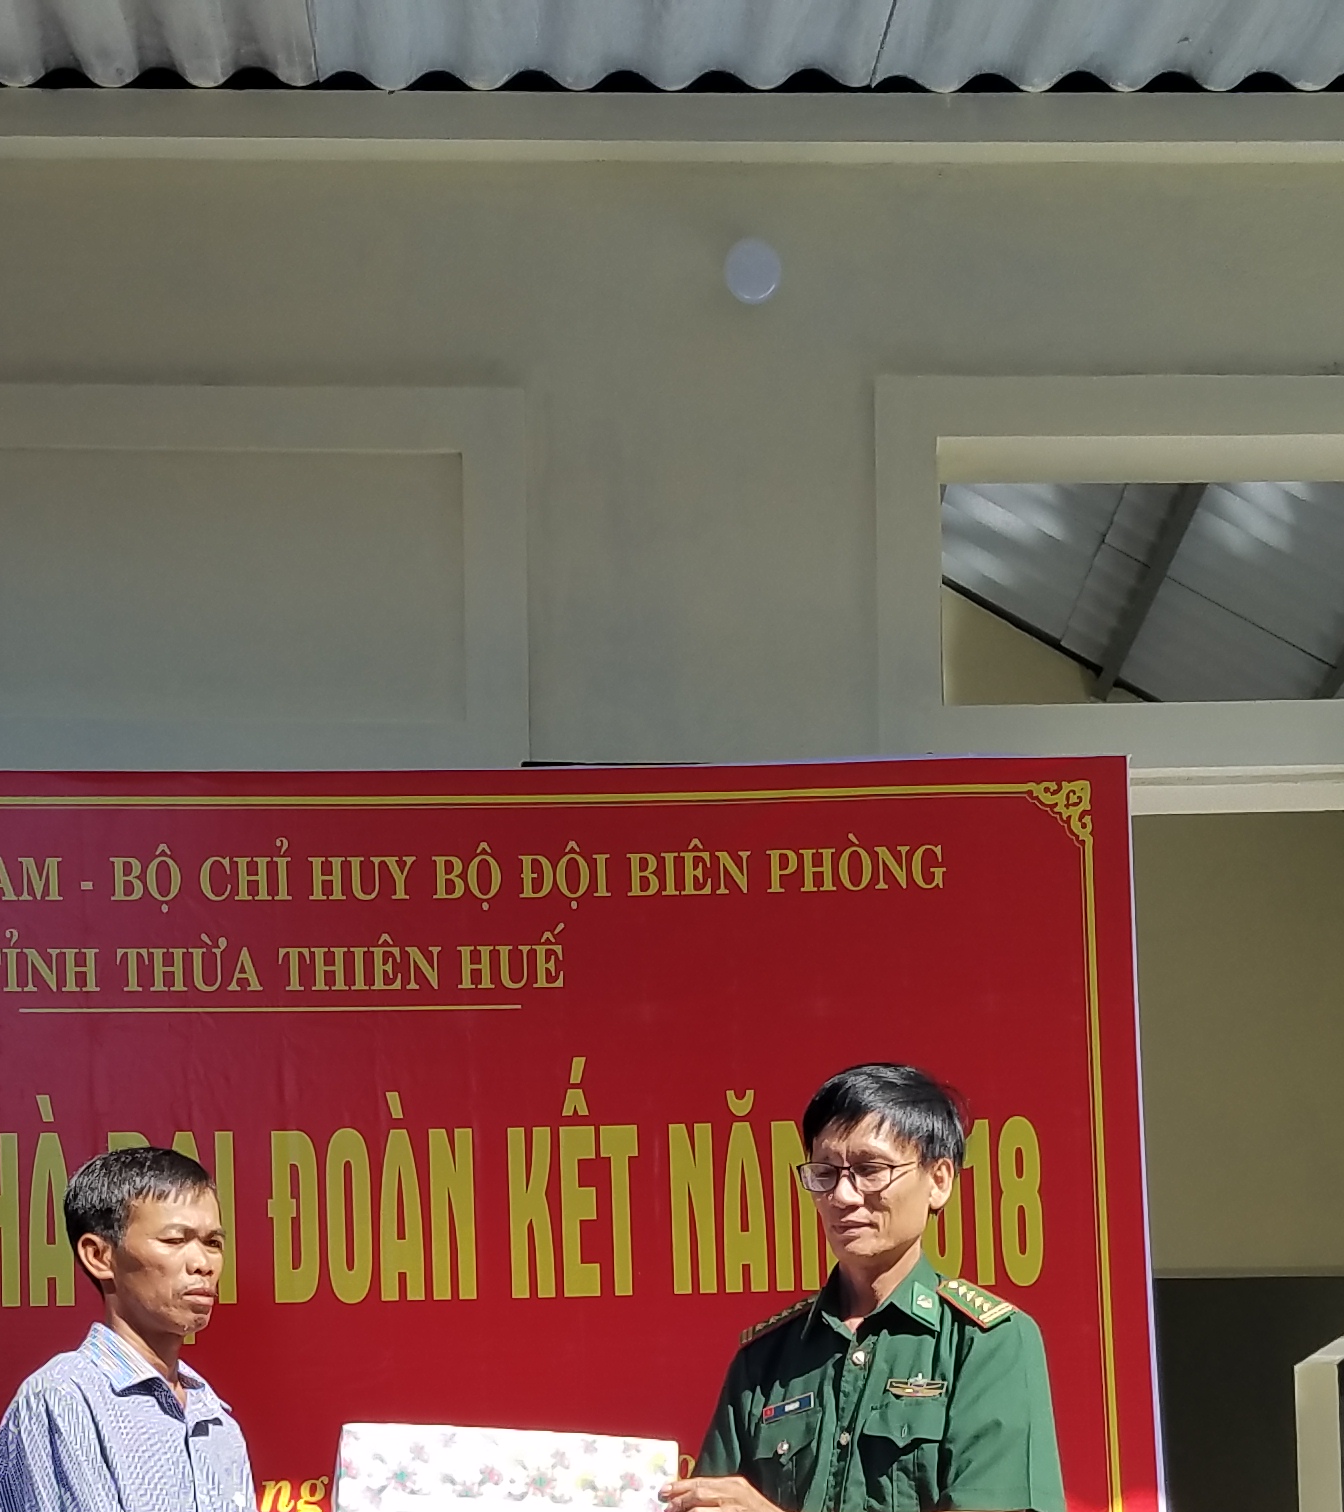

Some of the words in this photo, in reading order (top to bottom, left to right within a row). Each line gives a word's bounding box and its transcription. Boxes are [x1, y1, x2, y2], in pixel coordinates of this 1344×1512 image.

[110, 842, 182, 914] BỘ
[199, 837, 292, 902] CHỈ
[308, 856, 416, 901] HUY
[431, 841, 502, 912] BỘ
[519, 840, 611, 911] ĐỘI
[626, 837, 752, 897] BIÊN
[766, 833, 947, 893] PHÒNG
[116, 936, 263, 993] THỪA
[278, 932, 442, 991] THIÊN
[455, 922, 566, 990] HUẾ
[267, 1091, 478, 1305] ĐOÀN
[506, 1056, 640, 1299] KẾT
